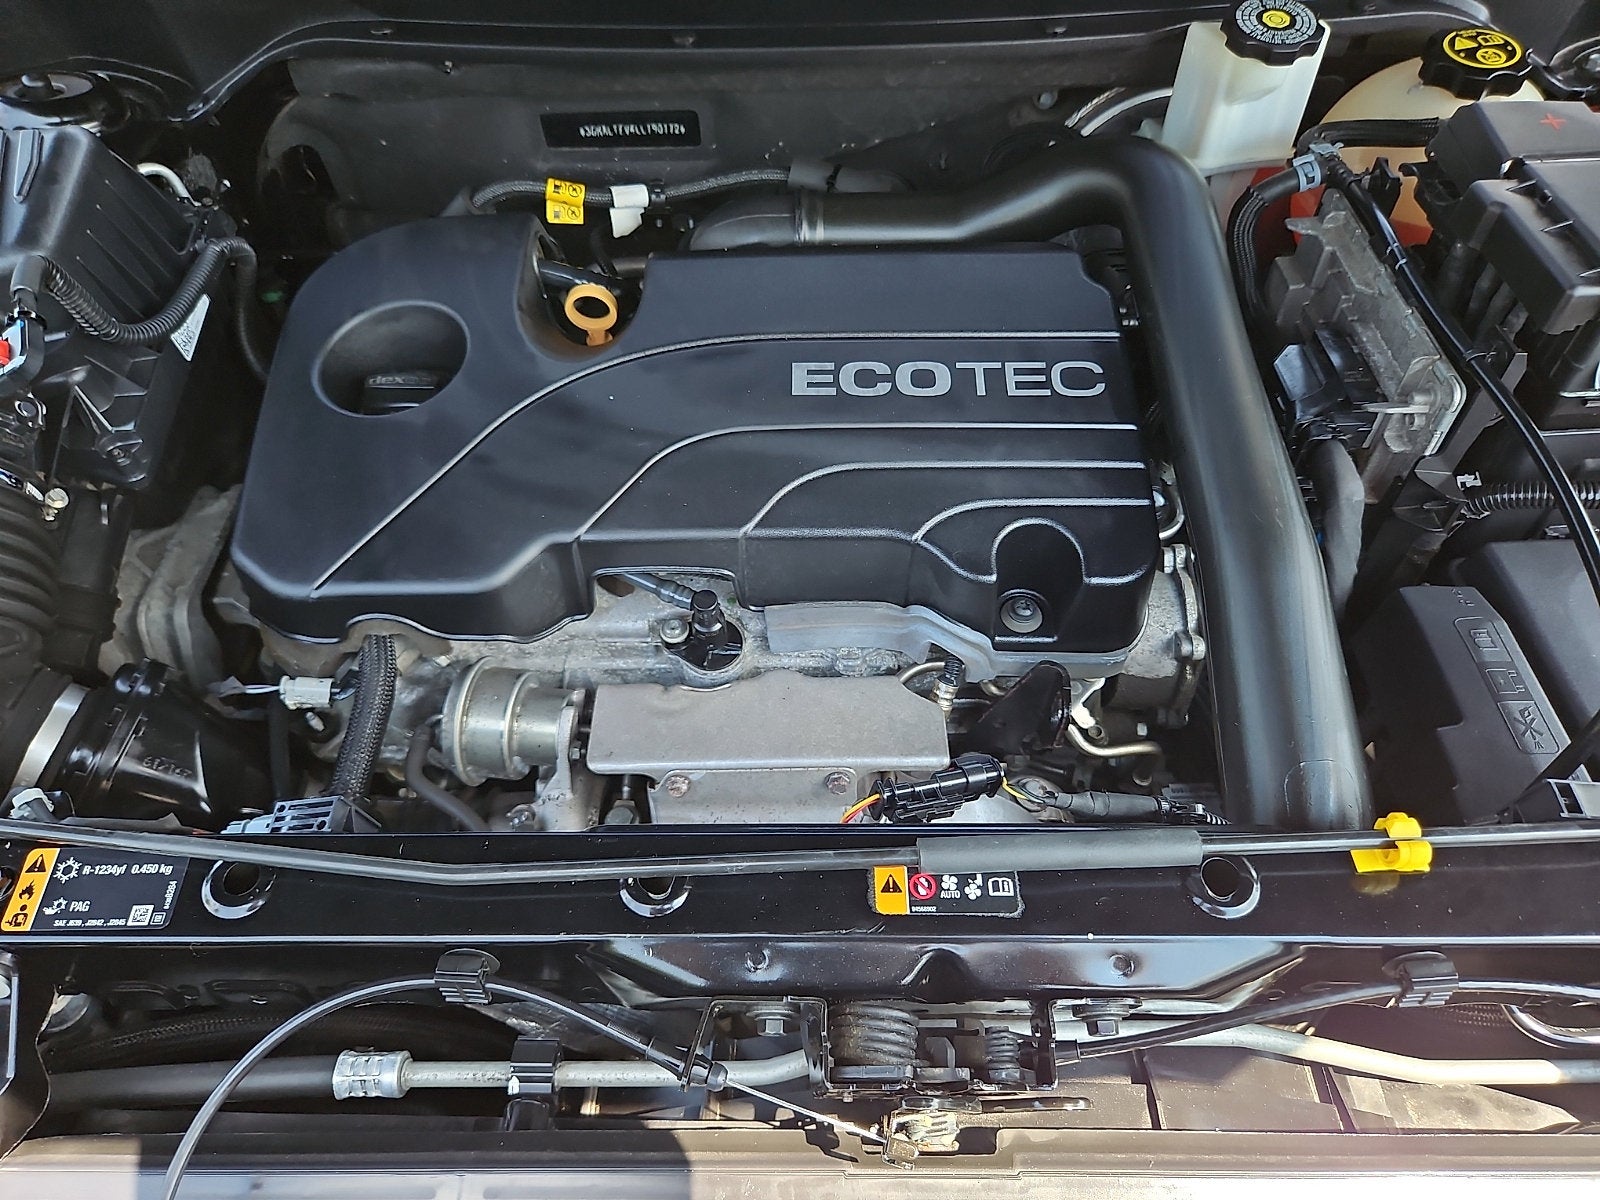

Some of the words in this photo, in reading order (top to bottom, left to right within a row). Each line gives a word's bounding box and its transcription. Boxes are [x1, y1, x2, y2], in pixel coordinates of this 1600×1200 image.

[791, 361, 1106, 397] ECOTEC
[82, 864, 127, 876] R-1234yf
[131, 863, 158, 874] 0.450
[159, 863, 173, 875] kg
[940, 890, 961, 899] AUTO
[69, 901, 91, 912] PAG
